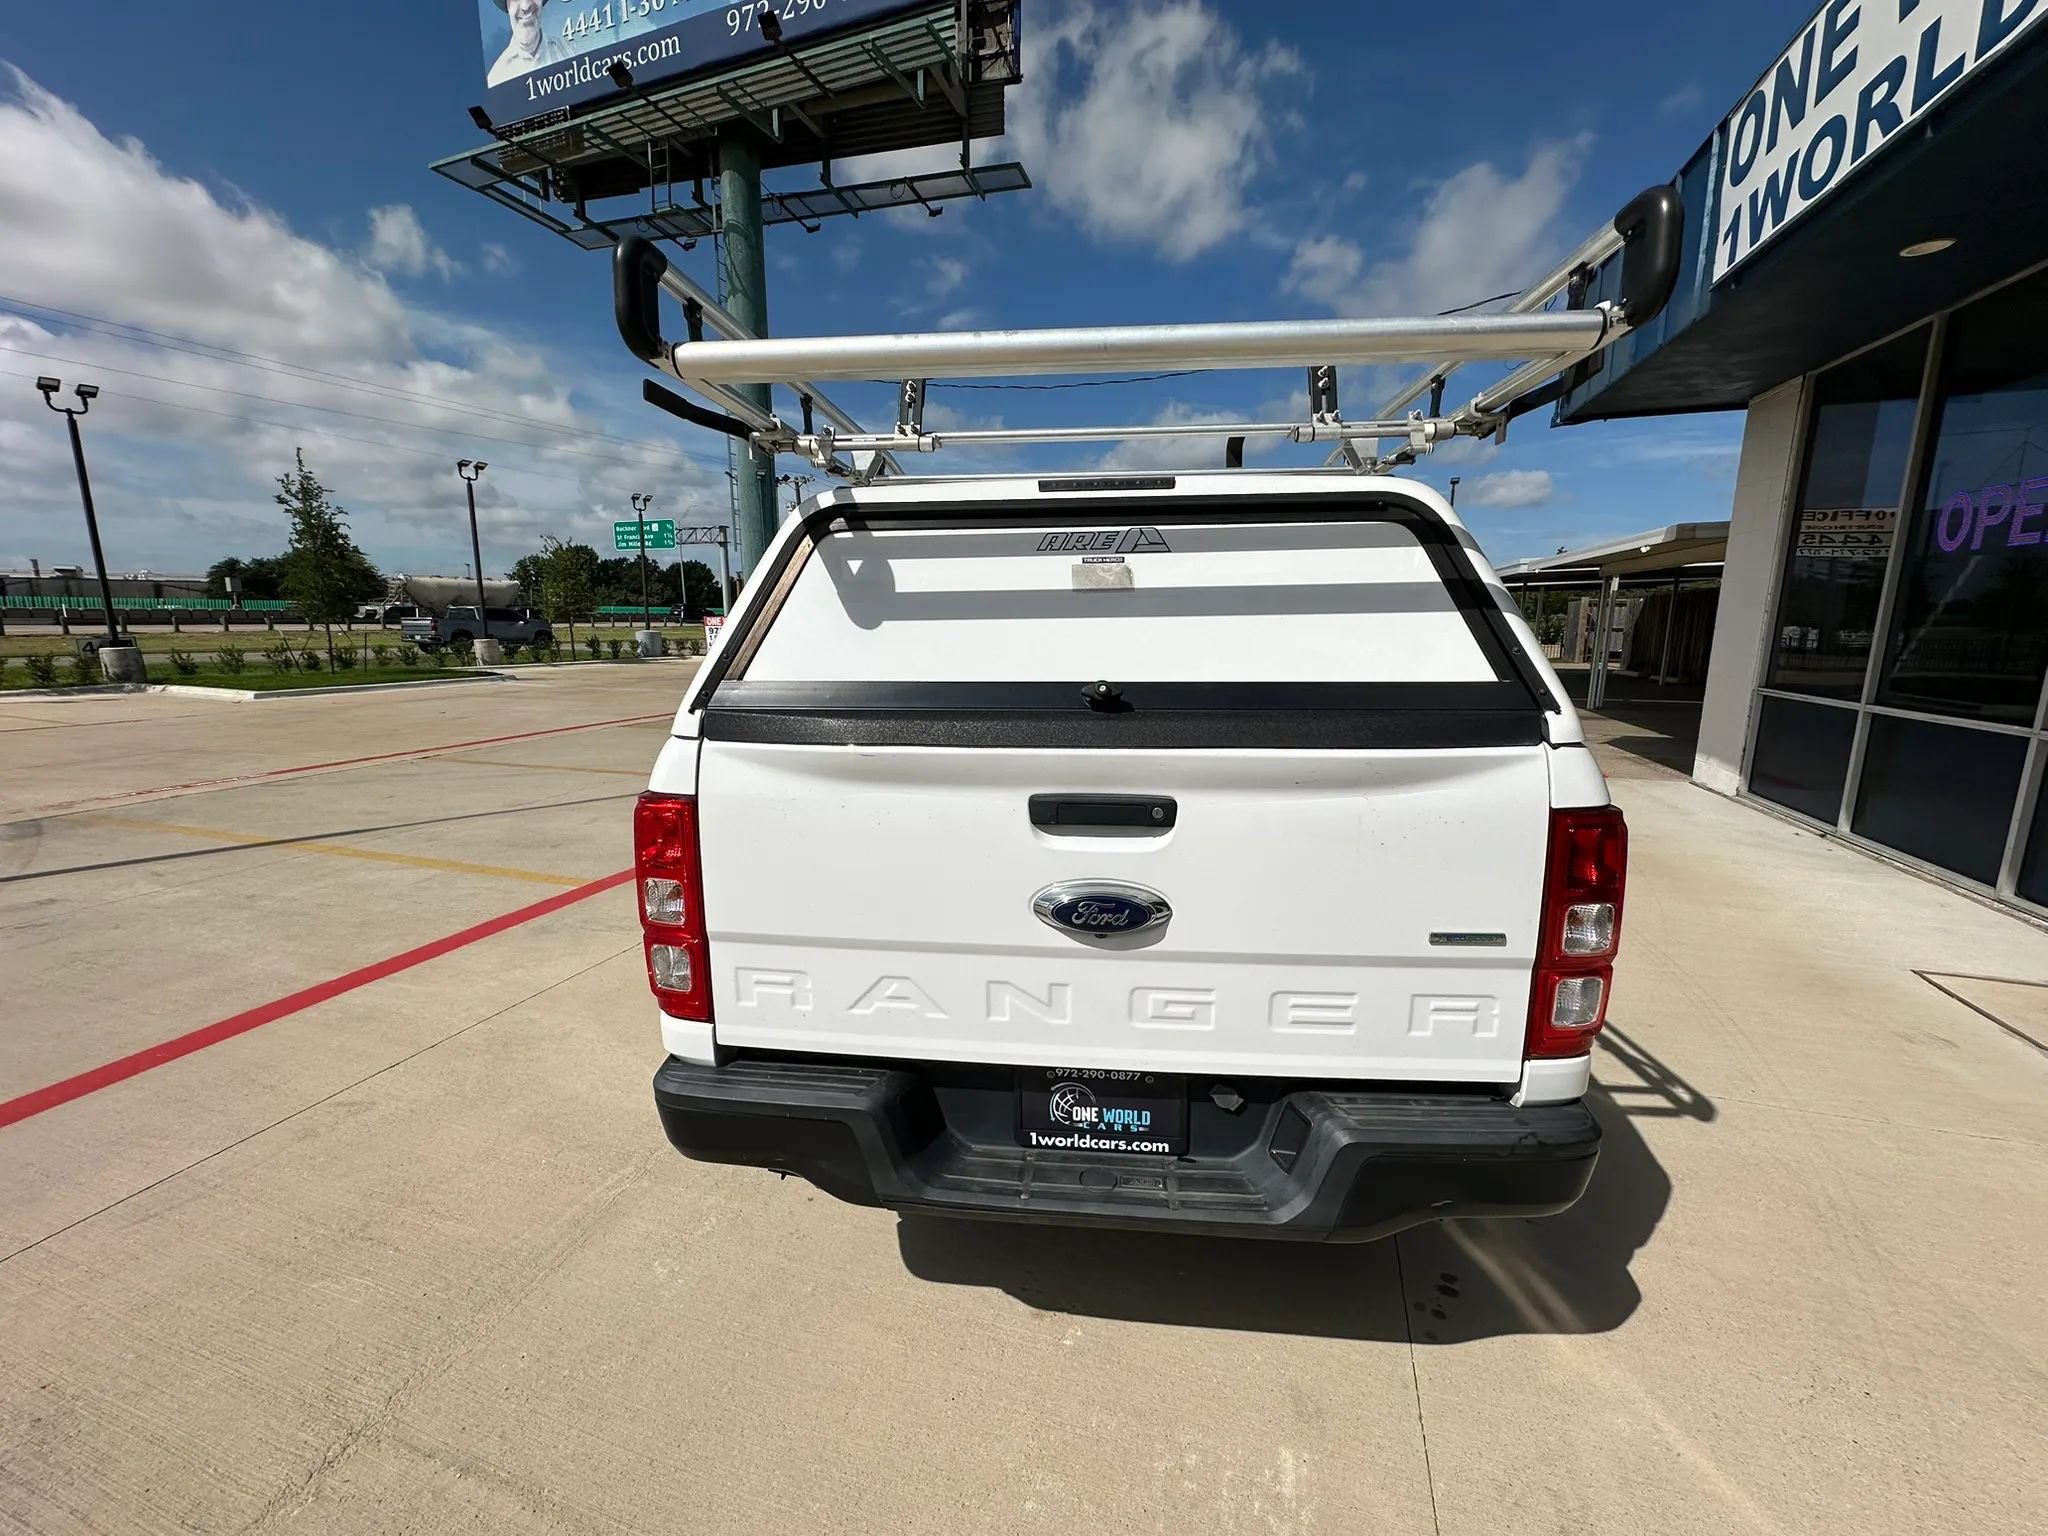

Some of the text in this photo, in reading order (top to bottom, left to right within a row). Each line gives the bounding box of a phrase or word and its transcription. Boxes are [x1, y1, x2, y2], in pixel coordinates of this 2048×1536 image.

[562, 3, 616, 41] 4441
[525, 35, 681, 101] 1worldcars.com
[1729, 0, 1861, 188] ONE
[1937, 476, 2048, 552] OPE
[1071, 901, 1130, 926] Ford
[735, 966, 1499, 1037] RANGER
[1055, 1068, 1142, 1081] 972-290-0877
[1072, 1106, 1151, 1126] ONE WORLD
[1083, 1121, 1138, 1132] CARS
[1030, 1132, 1169, 1152] 1worldcars.com
